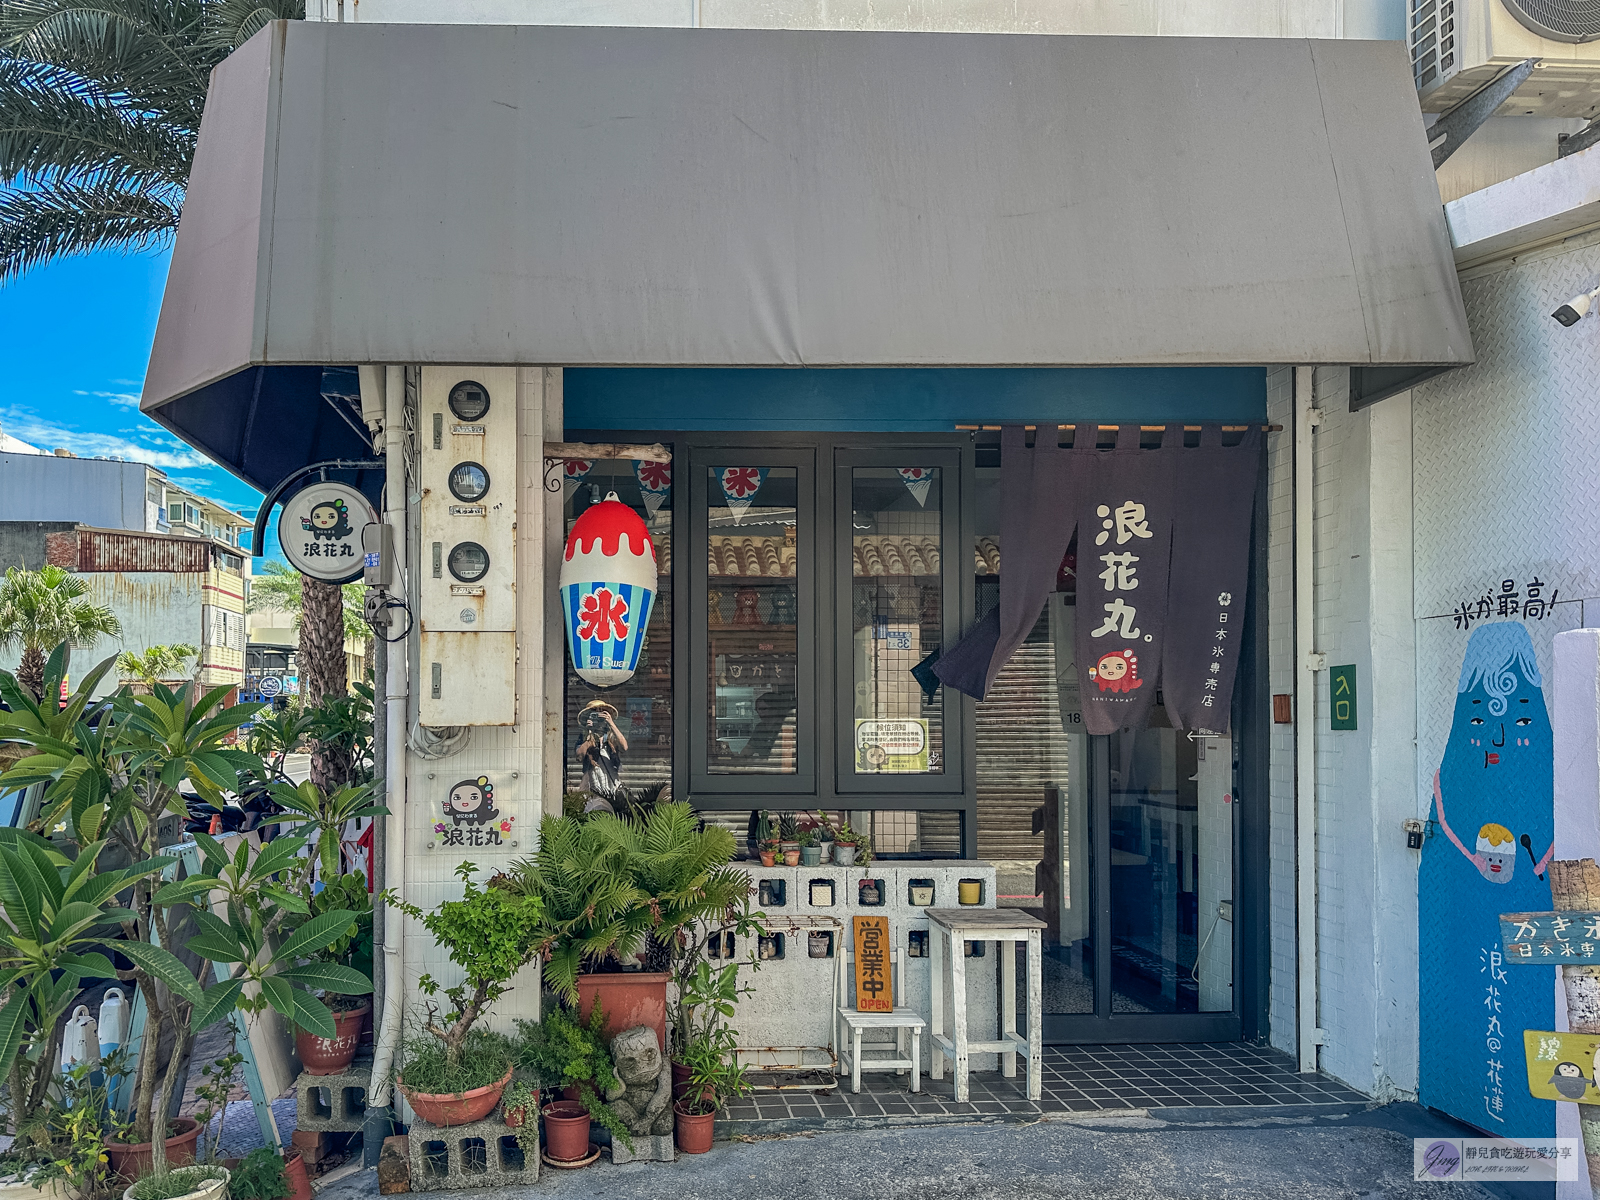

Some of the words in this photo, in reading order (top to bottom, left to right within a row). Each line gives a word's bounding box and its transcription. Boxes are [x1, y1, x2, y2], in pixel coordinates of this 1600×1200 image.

[303, 542, 355, 557] 浪花丸
[579, 588, 629, 641] 氷
[602, 656, 630, 667] Swan
[1201, 612, 1228, 707] 日本氷専売店
[1335, 675, 1350, 720] 入口
[1066, 712, 1082, 724] 18
[442, 827, 503, 846] 浪花丸
[860, 999, 889, 1009] OPEN
[1479, 943, 1508, 1123] 浪花丸@花蓮
